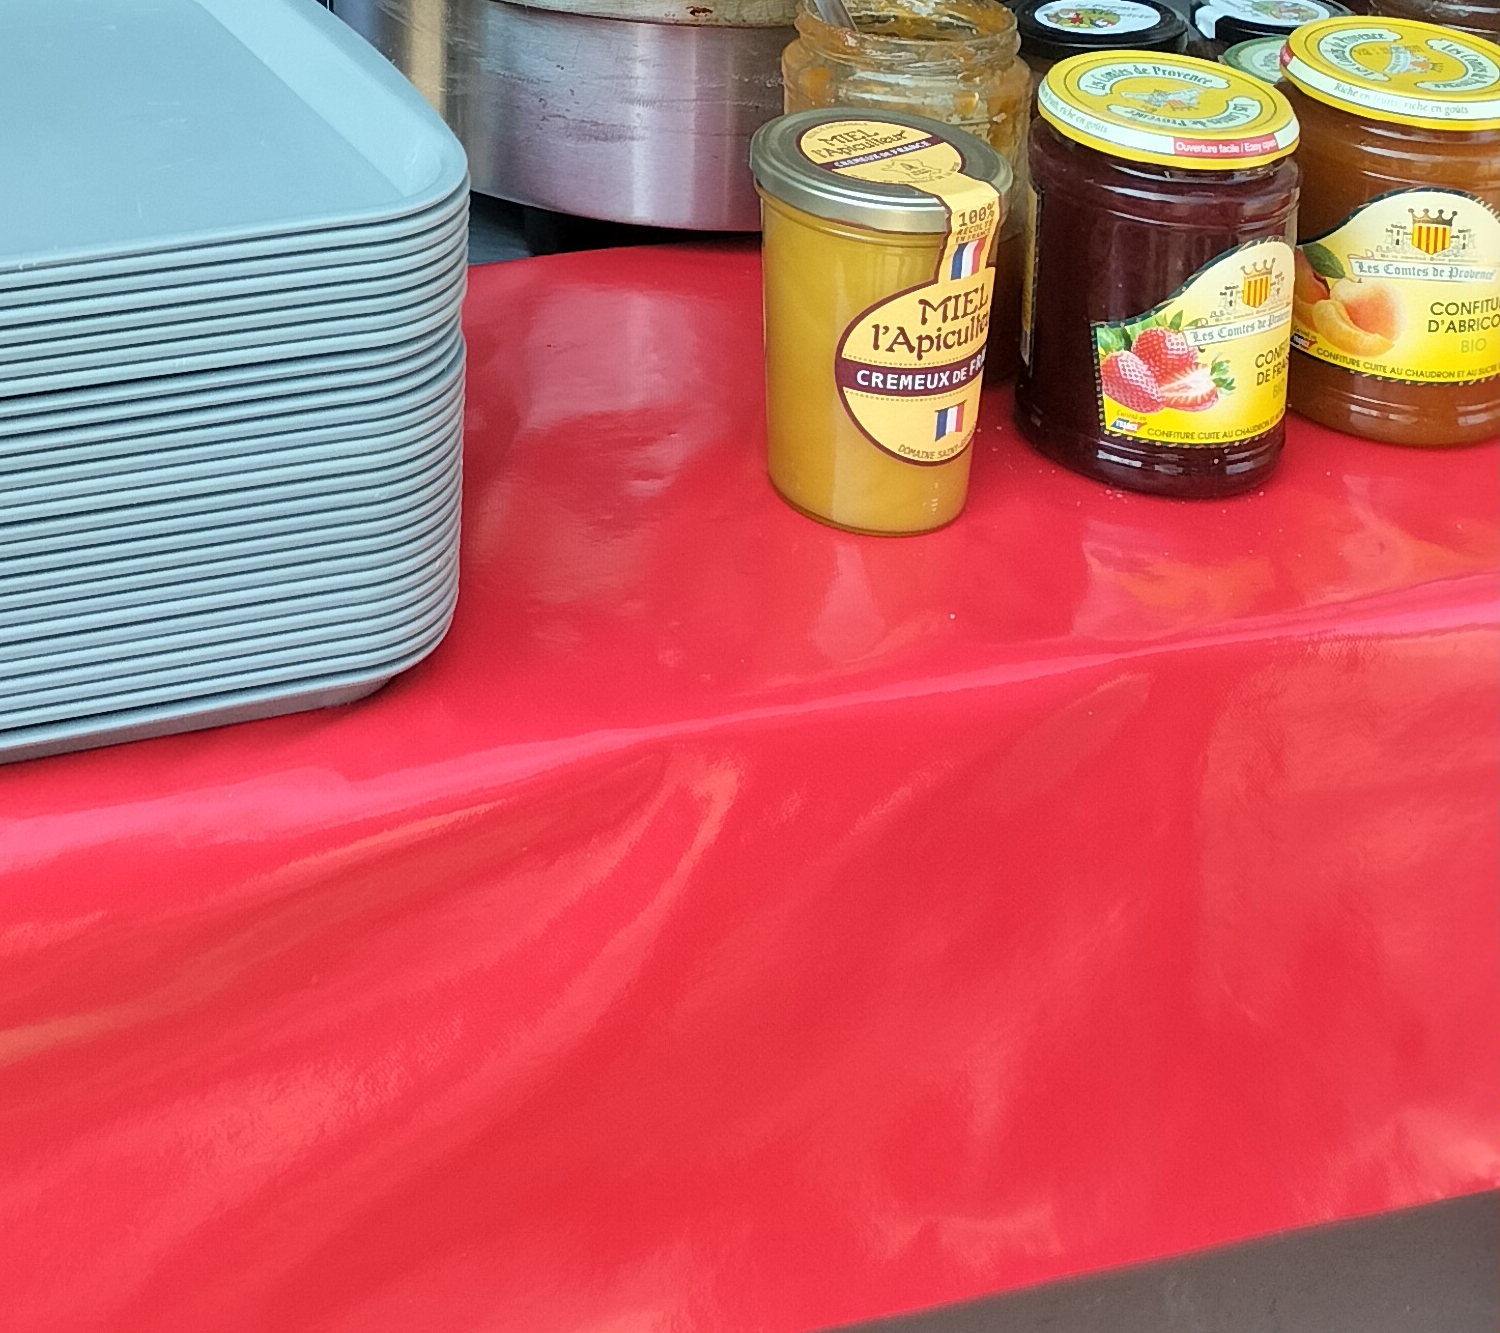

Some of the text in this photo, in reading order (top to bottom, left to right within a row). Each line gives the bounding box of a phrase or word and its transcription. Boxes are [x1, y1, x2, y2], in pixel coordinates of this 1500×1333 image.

[1151, 66, 1213, 85] Provence
[1334, 83, 1359, 98] Riche
[1405, 101, 1428, 112] riche
[1430, 105, 1442, 113] en
[817, 129, 880, 146] MIEL
[1176, 141, 1218, 154] Ouverture
[1219, 142, 1240, 154] facile
[1244, 141, 1262, 154] Easy
[959, 201, 996, 228] 100%
[1355, 260, 1496, 281] Les Comtes de Provence
[918, 283, 989, 326] MIEL
[1193, 331, 1214, 343] Les
[1218, 323, 1255, 339] Comtes
[1460, 338, 1487, 354] BIO
[1317, 347, 1360, 367] CONFITURE
[1363, 359, 1387, 373] CUITE
[1390, 367, 1403, 375] AU
[1405, 369, 1455, 379] CHAUDRON
[1457, 370, 1465, 378] ET
[856, 369, 950, 391] CREMEUX
[953, 367, 967, 384] DE
[1257, 369, 1270, 386] DE
[1147, 428, 1196, 440] CONFITURE
[1198, 431, 1220, 440] CUITE
[1222, 429, 1234, 438] AU
